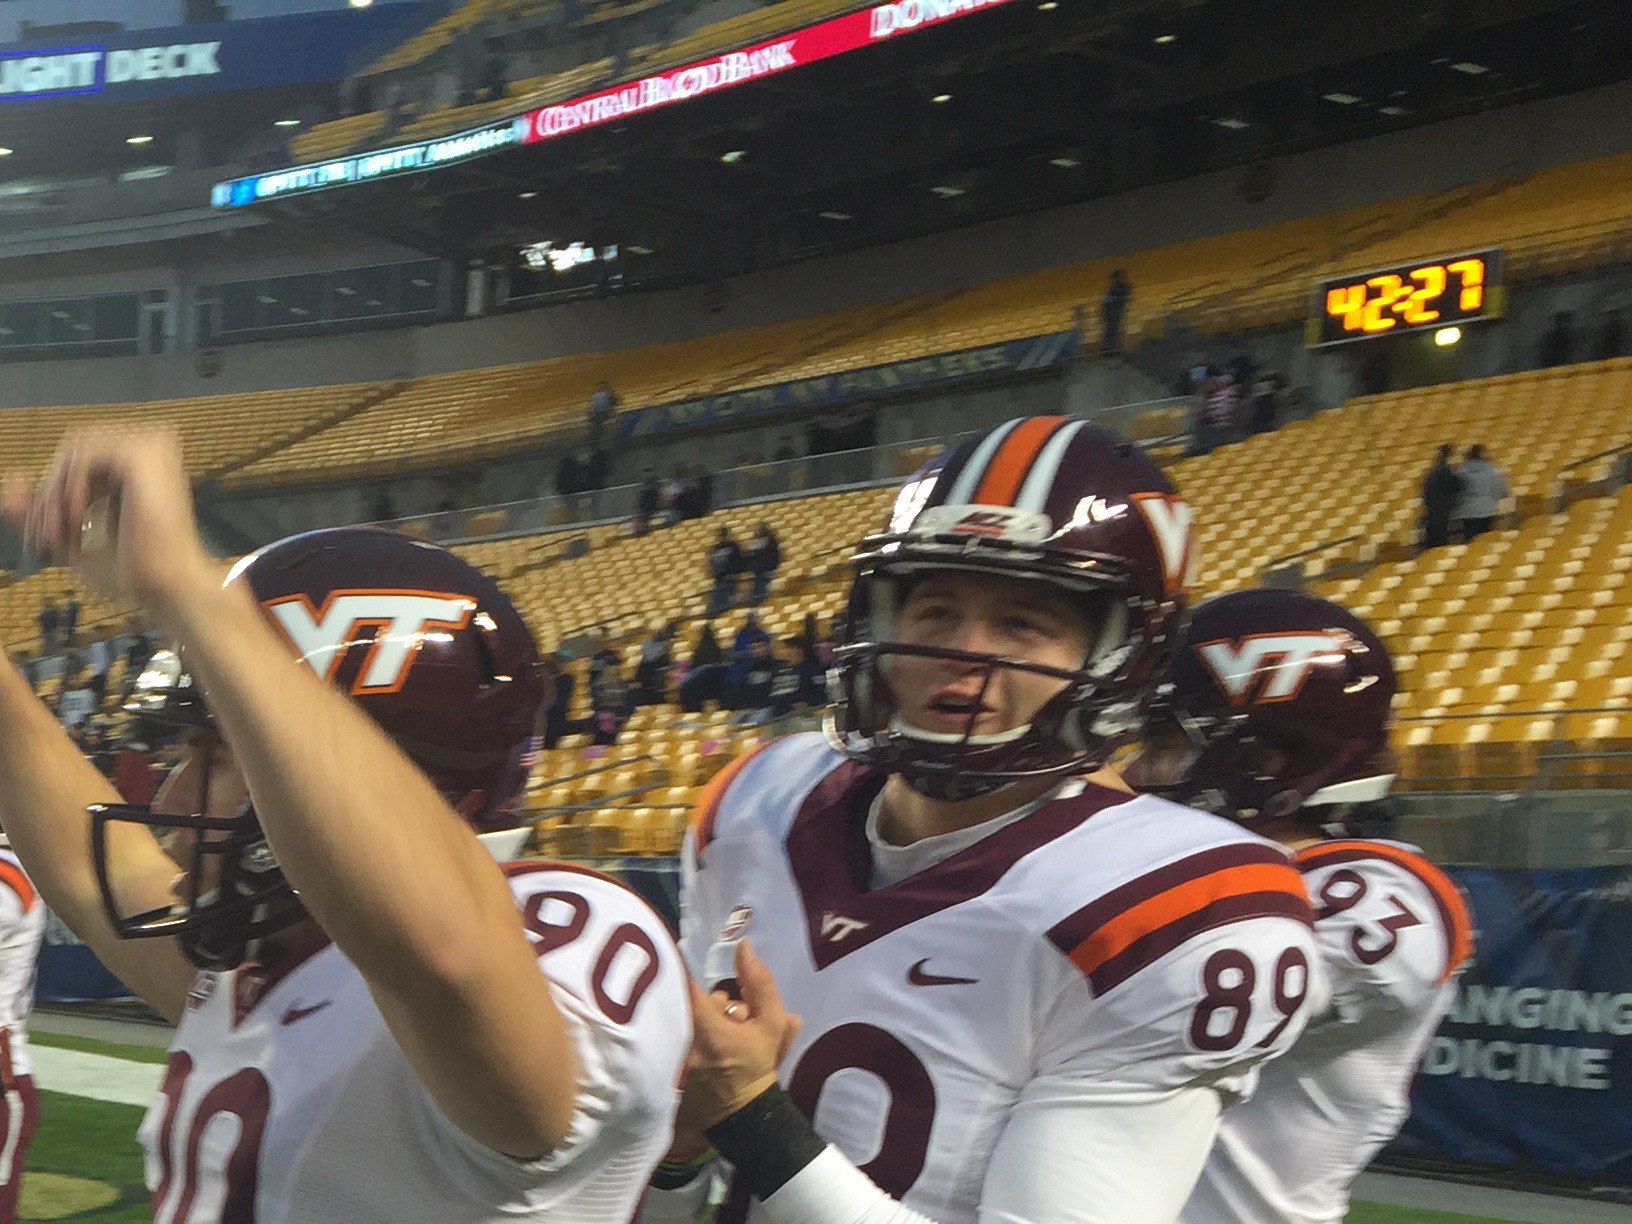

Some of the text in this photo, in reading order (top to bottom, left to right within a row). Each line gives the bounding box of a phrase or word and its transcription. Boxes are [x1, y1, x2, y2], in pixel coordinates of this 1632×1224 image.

[105, 41, 222, 83] DECK
[1326, 258, 1485, 332] 42:27
[261, 588, 478, 697] VT
[1193, 629, 1344, 706] VT
[523, 889, 660, 1025] 90
[819, 911, 870, 942] VT
[1313, 869, 1422, 965] 93
[1189, 946, 1309, 1052] 89
